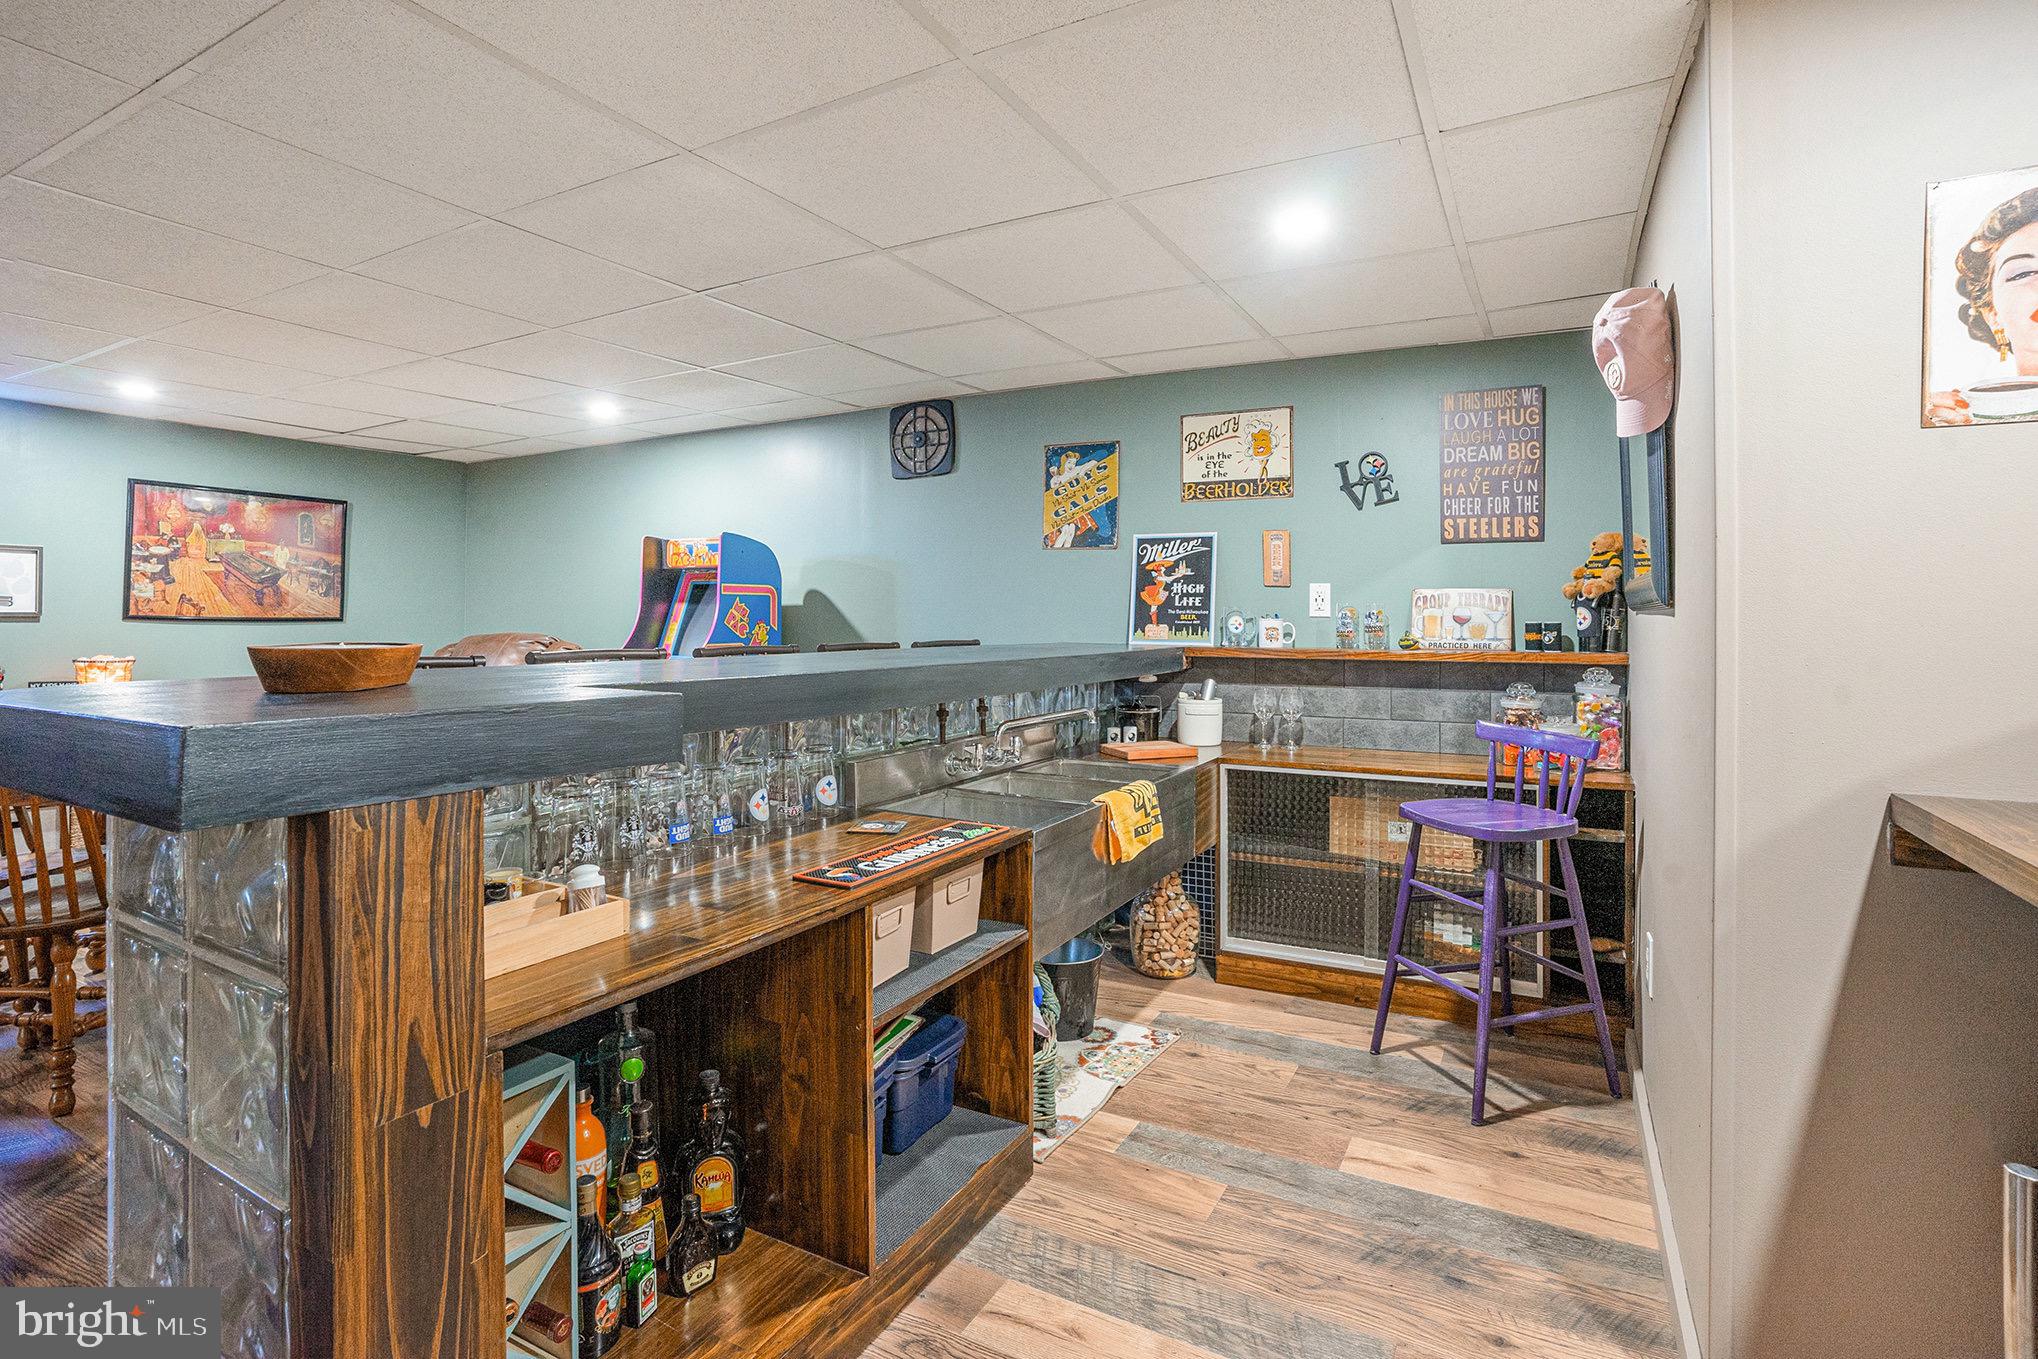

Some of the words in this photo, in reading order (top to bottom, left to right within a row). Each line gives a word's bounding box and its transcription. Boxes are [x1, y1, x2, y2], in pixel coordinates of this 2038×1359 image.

[1444, 394, 1454, 411] IN
[1459, 392, 1480, 410] THIS
[1484, 389, 1517, 408] HOUSE
[1522, 388, 1539, 405] WE
[1444, 411, 1493, 430] LOVE
[1497, 407, 1540, 426] HUG
[1185, 414, 1240, 454] BEAUTY
[1444, 429, 1492, 446] LAUGH
[1497, 430, 1507, 442] A
[1512, 427, 1540, 441] LOT
[1217, 452, 1232, 460] the
[1444, 445, 1502, 463] DREAM
[1507, 441, 1540, 460] BIG
[1201, 471, 1211, 479] of
[1213, 469, 1228, 477] the
[1205, 460, 1225, 469] EYE
[1444, 467, 1467, 478] are
[1473, 460, 1539, 482] grateful
[1053, 461, 1108, 497] GUYS
[1443, 482, 1490, 496] HAVE
[1502, 479, 1538, 494] FUN
[1184, 480, 1289, 500] BEERHOLDER
[1053, 484, 1108, 518] GALS
[1444, 497, 1482, 516] CHEER
[1488, 496, 1510, 515] FOR
[1516, 495, 1539, 514] THE
[1443, 515, 1540, 540] STEELERS
[1138, 538, 1204, 565] Miller
[1171, 580, 1205, 596] HIGH
[1174, 595, 1202, 606] LIFE
[1415, 593, 1450, 608] GROUP
[1457, 593, 1508, 609] THERAPY
